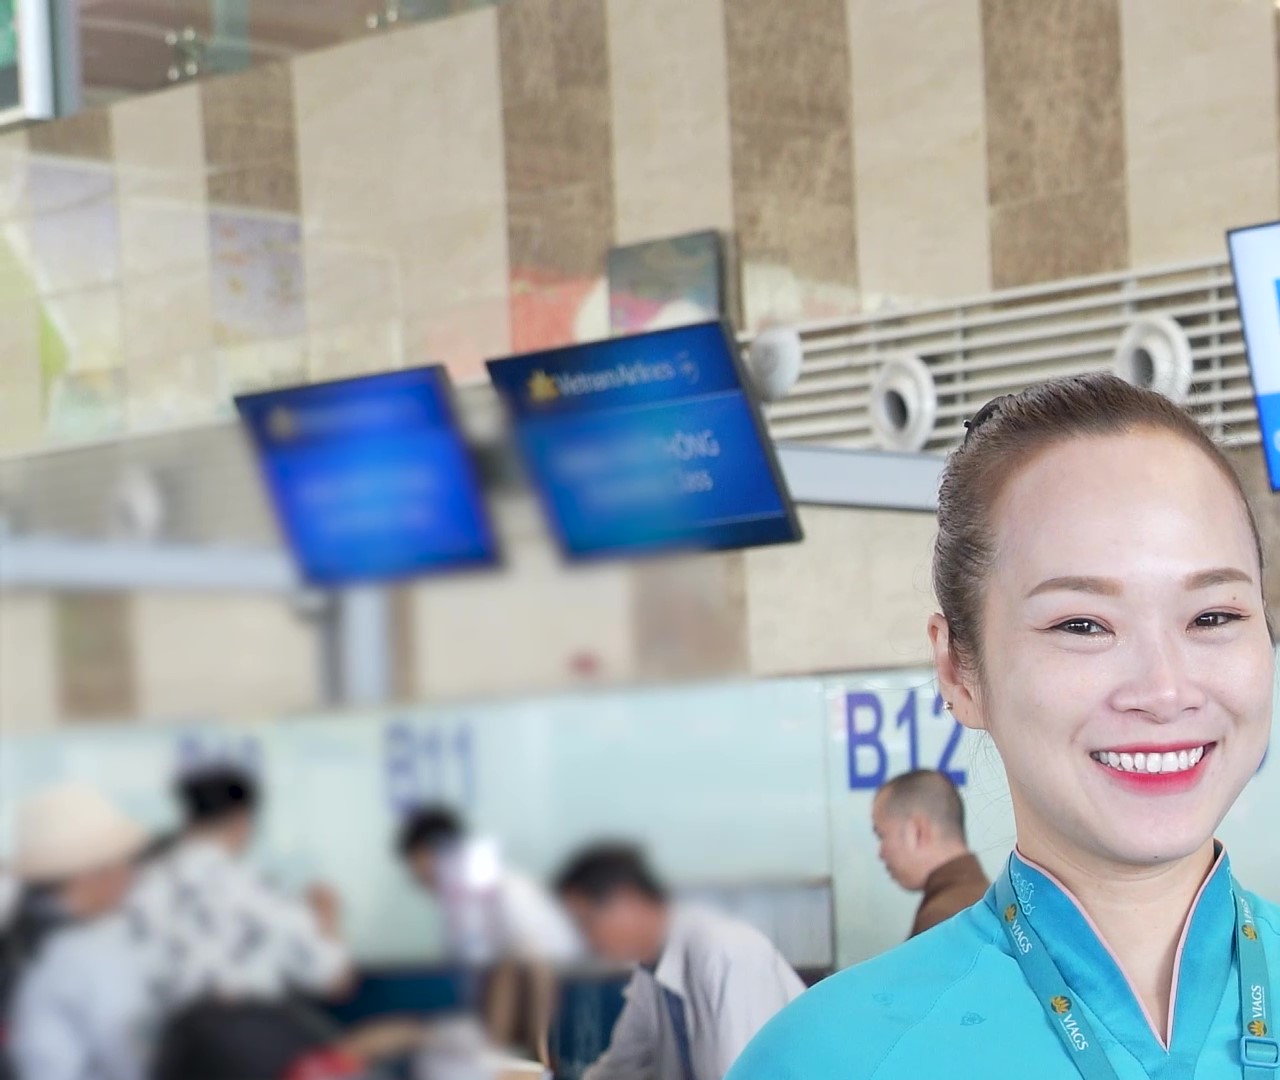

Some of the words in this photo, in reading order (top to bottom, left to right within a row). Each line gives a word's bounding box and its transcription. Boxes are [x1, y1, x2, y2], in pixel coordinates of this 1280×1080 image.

[1012, 919, 1032, 953] VIAGS
[1253, 984, 1262, 1018] VIAGS
[1063, 1013, 1089, 1050] VIAGS
